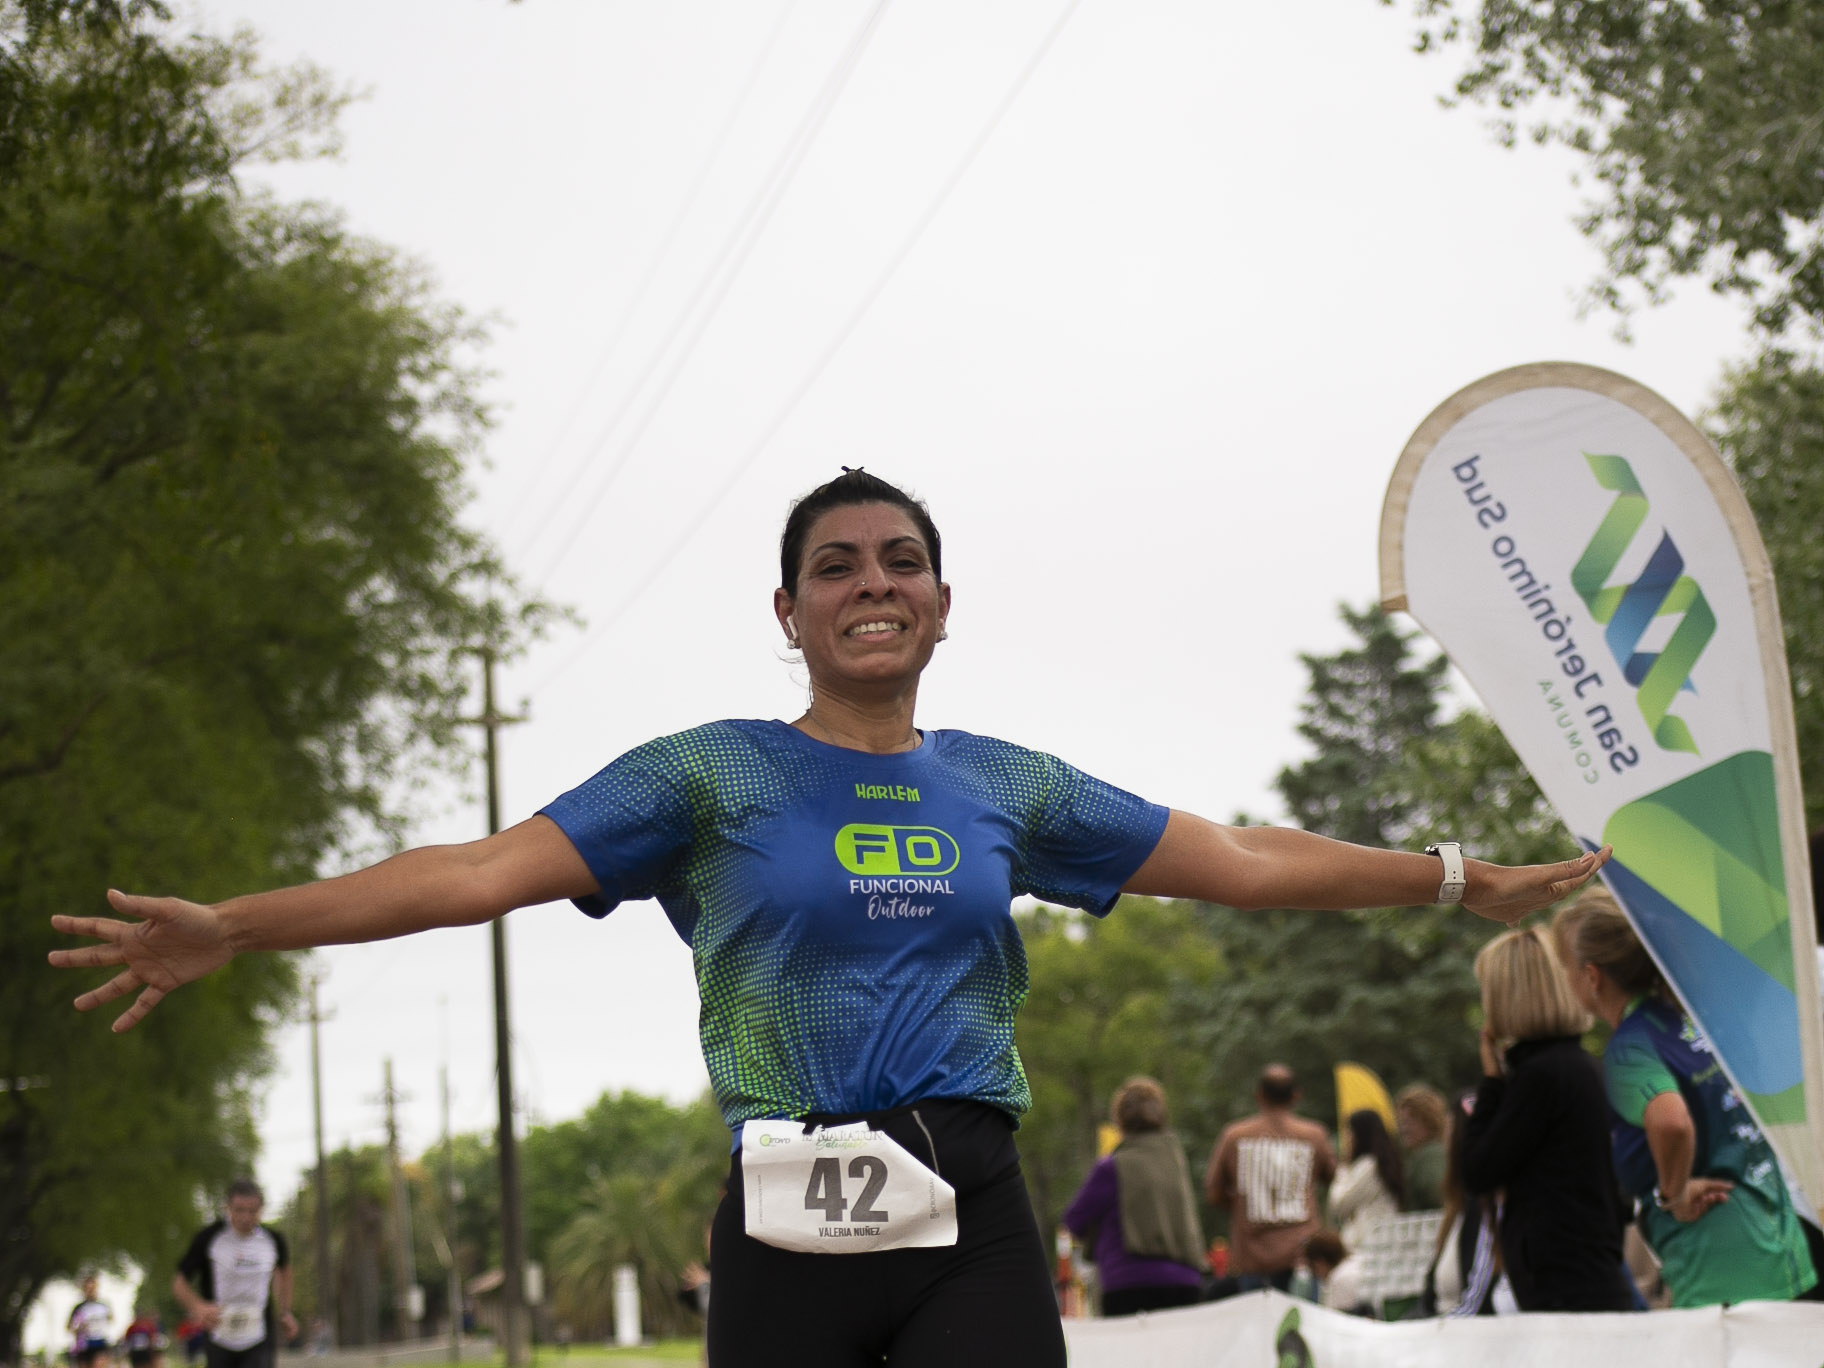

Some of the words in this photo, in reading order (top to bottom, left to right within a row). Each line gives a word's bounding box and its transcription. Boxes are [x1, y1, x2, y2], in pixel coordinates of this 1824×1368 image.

[854, 783, 921, 802] HARLEM
[849, 878, 955, 895] FUNCIONAL
[867, 894, 935, 920] Outdoor
[804, 1155, 889, 1223] 42
[818, 1227, 853, 1238] VALERIA
[853, 1225, 881, 1237] NUÑEZ
